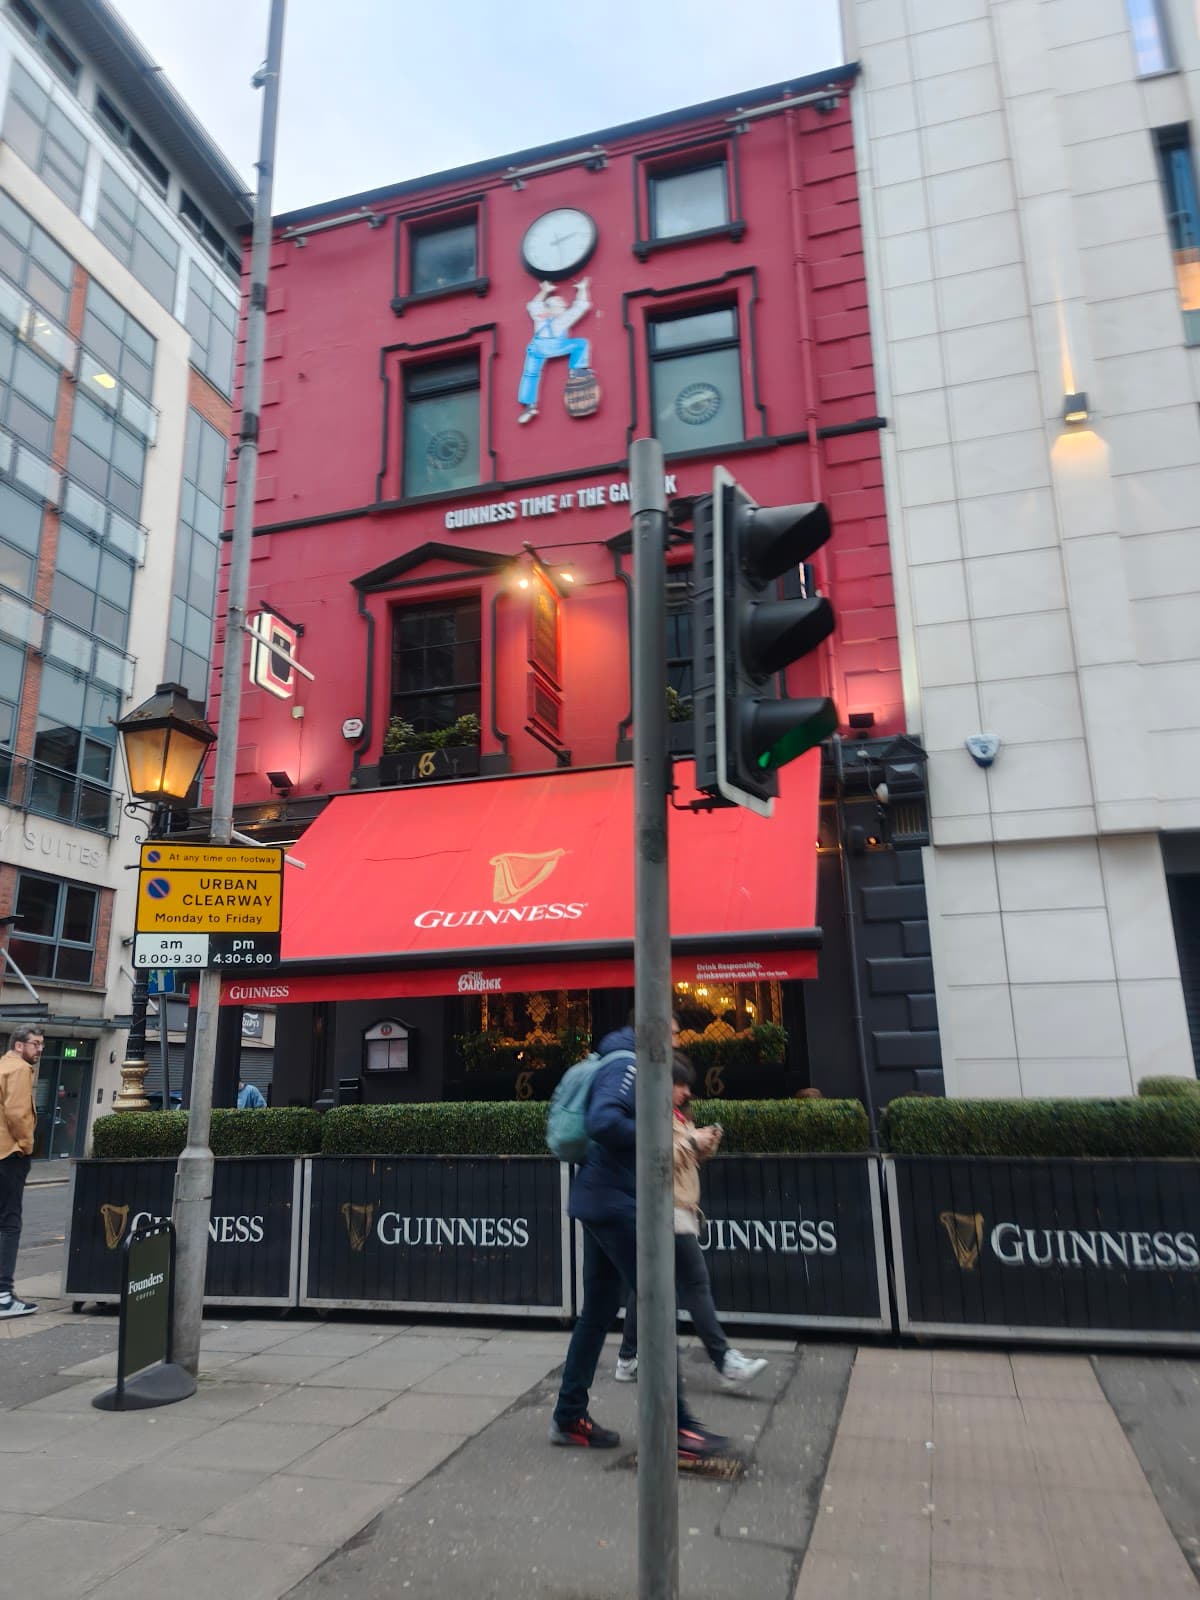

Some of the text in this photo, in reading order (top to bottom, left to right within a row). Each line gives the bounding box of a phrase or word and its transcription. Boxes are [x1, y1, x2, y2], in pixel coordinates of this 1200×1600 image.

[445, 502, 516, 529] GUINNESS
[520, 494, 555, 517] TIME
[559, 494, 573, 509] AT
[577, 486, 606, 507] THE
[24, 832, 103, 868] SUITES
[183, 855, 199, 863] any
[203, 854, 223, 862] time
[240, 855, 276, 864] footway
[200, 878, 257, 890] URBAN
[182, 894, 273, 907] CLEARWAY
[155, 913, 263, 925] Monday to Friday
[414, 902, 586, 929] GUINNESS
[160, 940, 183, 949] am
[232, 940, 255, 951] pm
[138, 954, 202, 964] 8.00-9.30
[213, 953, 273, 964] 4.30-6.00
[697, 963, 716, 971] Drink
[230, 985, 289, 1000] GUINNESS
[377, 1211, 529, 1247] GUINNESS
[990, 1222, 1200, 1269] GUINNESS
[128, 1272, 164, 1295] Founders
